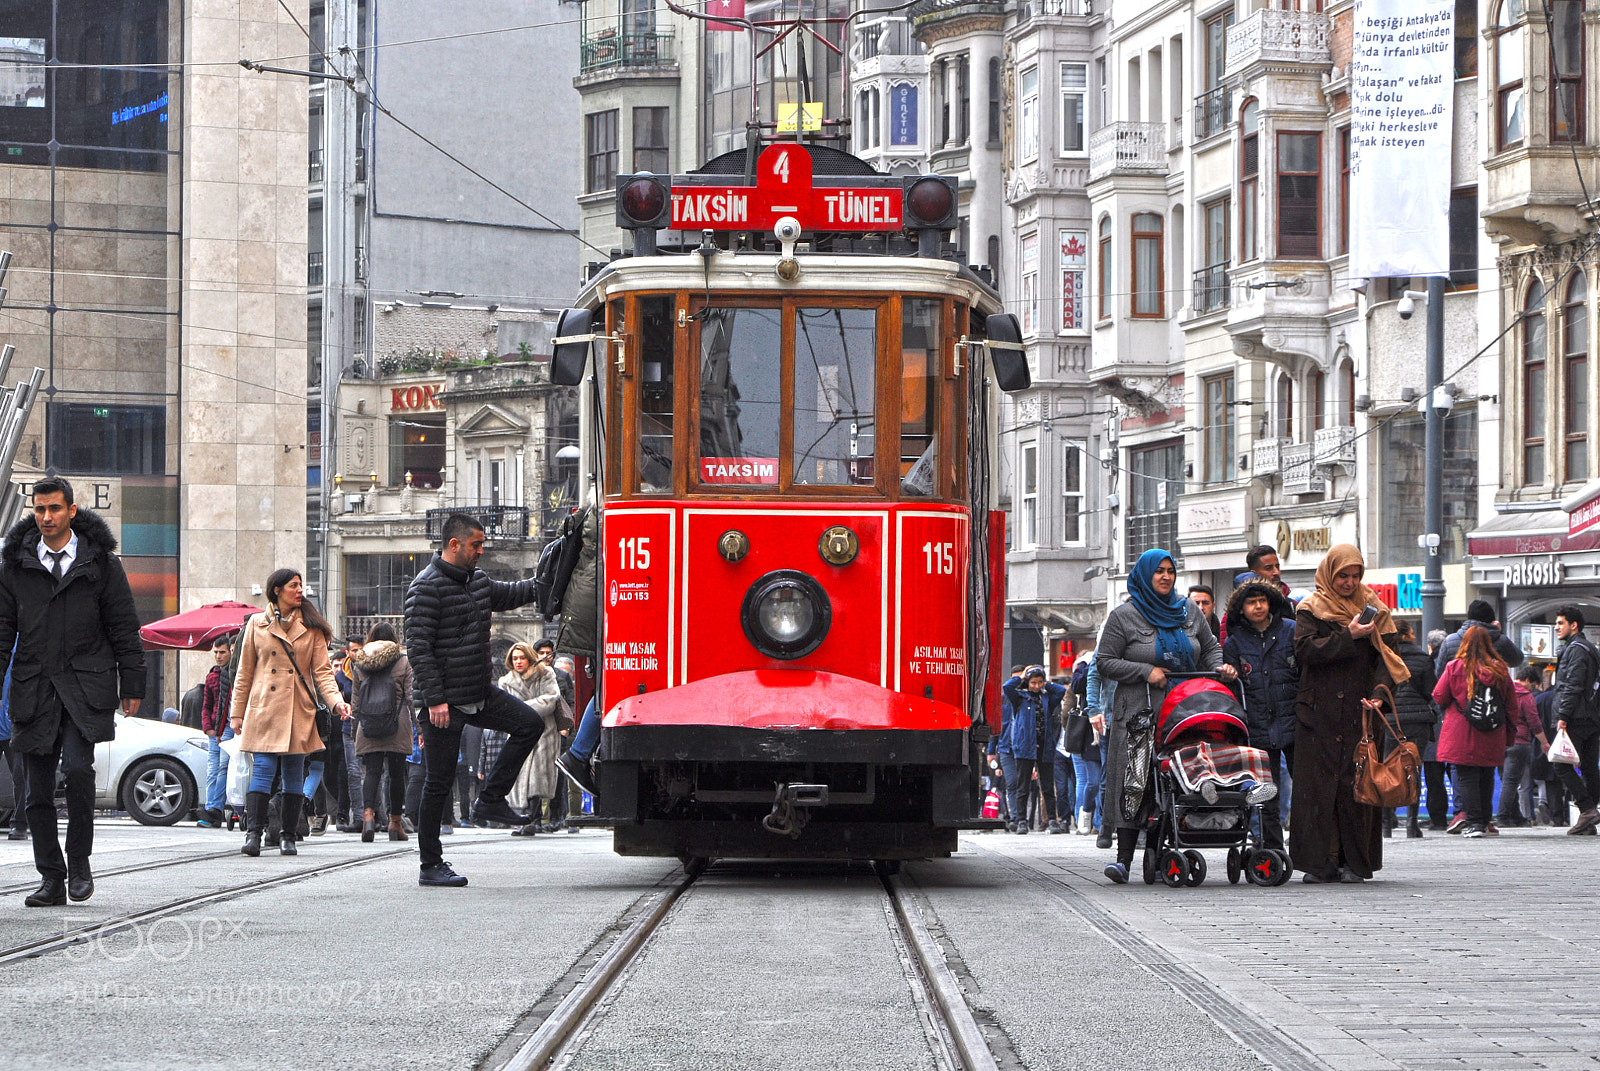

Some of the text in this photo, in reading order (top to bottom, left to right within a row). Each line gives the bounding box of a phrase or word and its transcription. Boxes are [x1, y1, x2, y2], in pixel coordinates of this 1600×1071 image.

[1367, 16, 1403, 30] beşiği
[1398, 26, 1450, 42] devletinden
[1408, 79, 1419, 88] ve
[1420, 73, 1442, 86] fakat
[1375, 91, 1403, 102] dolu
[1428, 121, 1438, 130] ve
[1381, 136, 1425, 149] isteyen
[773, 151, 790, 183] 4
[671, 190, 898, 223] TAKSİM TÜNEL
[1064, 272, 1073, 328] KANADA
[705, 461, 774, 477] TAKSİM
[618, 537, 651, 570] 115
[922, 542, 953, 575] 115
[1503, 554, 1560, 598] patsosis
[619, 591, 633, 601] ALO
[634, 591, 649, 601] 153
[629, 641, 656, 655] YASAK
[914, 645, 947, 659] ASILMAK
[909, 661, 921, 674] VE
